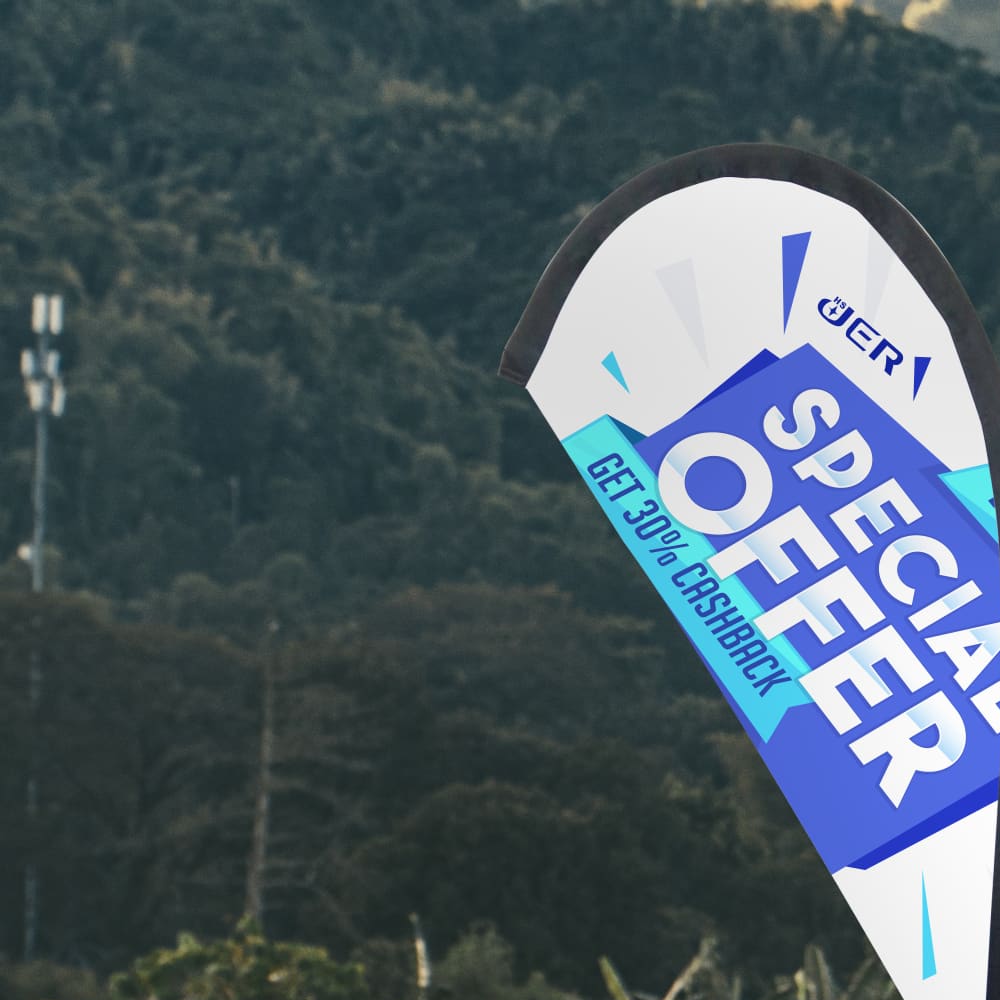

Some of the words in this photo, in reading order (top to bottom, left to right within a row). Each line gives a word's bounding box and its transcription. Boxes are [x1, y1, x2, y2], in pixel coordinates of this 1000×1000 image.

[587, 452, 646, 502] GET
[623, 498, 689, 567] 30%
[671, 561, 793, 698] CASHBACK
[658, 432, 967, 809] OFFER
